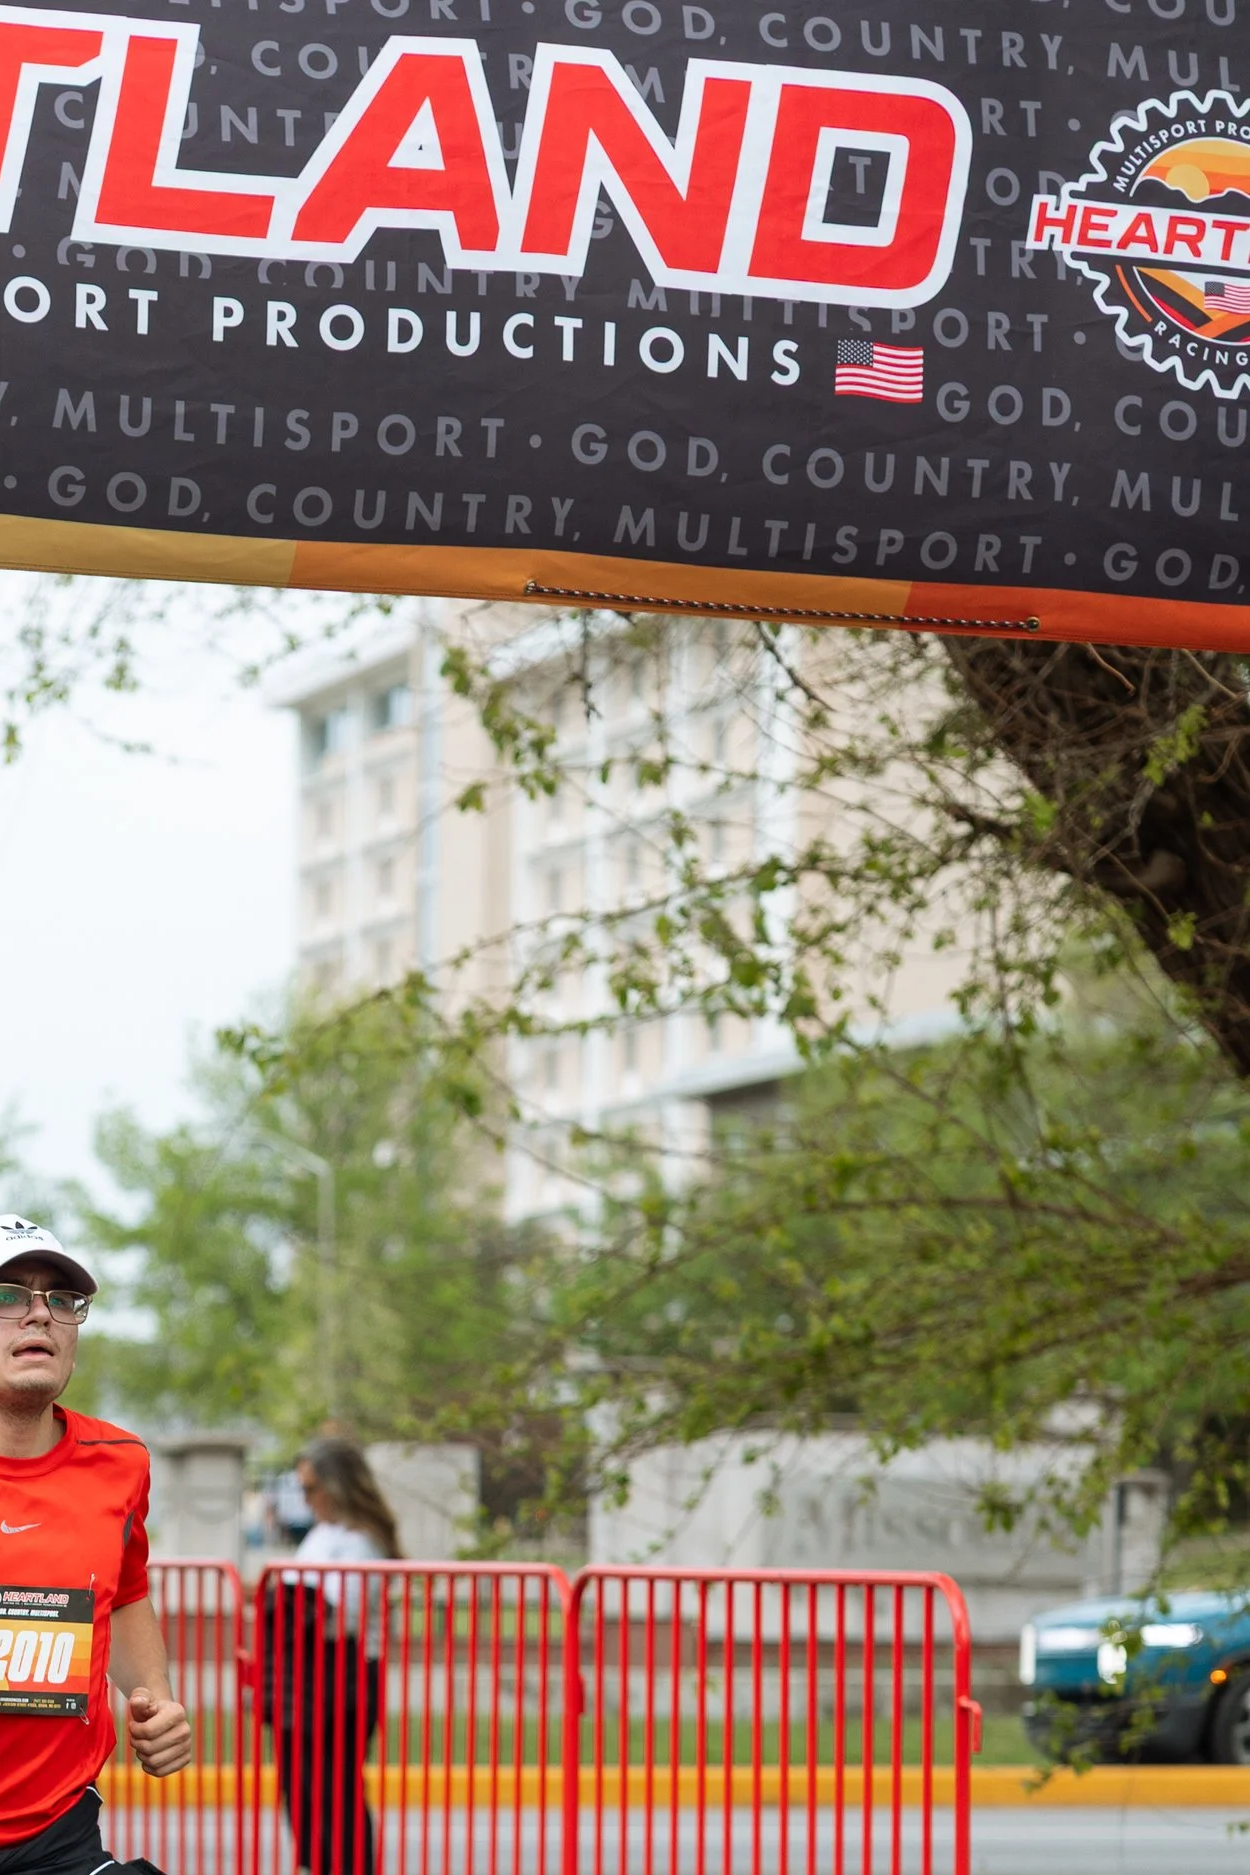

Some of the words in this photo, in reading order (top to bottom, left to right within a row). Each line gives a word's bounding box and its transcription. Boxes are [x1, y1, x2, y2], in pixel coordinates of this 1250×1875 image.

[564, 0, 727, 46] GOD,
[759, 13, 1075, 75] COUNTRY,
[1113, 120, 1207, 192] MULTISPORT
[1034, 202, 1250, 264] HEART
[211, 296, 801, 387] PRODUCTIONS
[1154, 320, 1249, 366] RACING
[937, 381, 1082, 432] GOD,
[52, 388, 505, 459] MULTISPORT
[571, 423, 729, 483] GOD,
[762, 443, 1079, 506] COUNTRY,
[48, 465, 211, 523] GOD,
[246, 483, 581, 542] COUNTRY,
[613, 505, 1043, 575] MULTISPORT
[1103, 543, 1246, 595] GOD,
[2, 1591, 69, 1605] HEARTLAND
